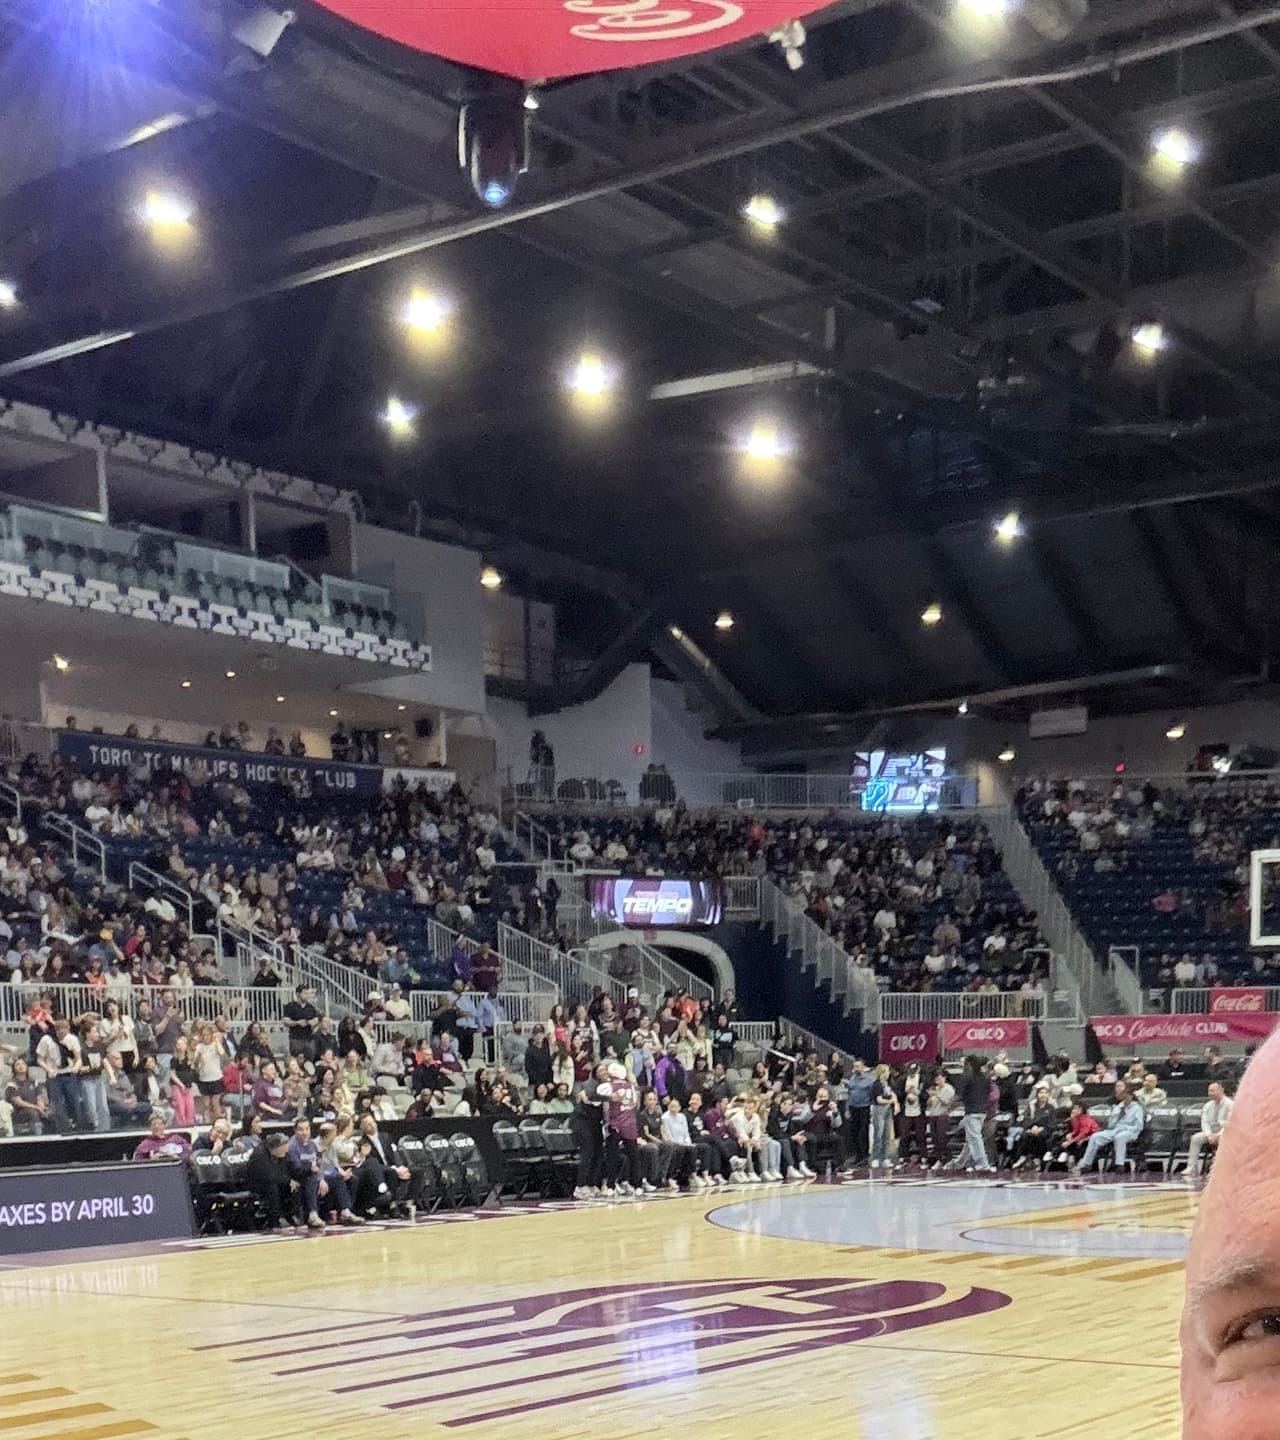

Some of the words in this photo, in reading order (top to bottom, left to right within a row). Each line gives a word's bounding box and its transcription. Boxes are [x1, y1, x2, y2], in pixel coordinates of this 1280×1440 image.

[89, 745, 162, 771] TOROTO
[245, 763, 307, 783] HOCEY
[314, 769, 356, 789] LUB
[622, 897, 693, 913] TEMPO
[1214, 994, 1263, 1011] Coca-Cola
[966, 1028, 995, 1041] CIBC
[1128, 1019, 1193, 1040] Courtside
[1195, 1022, 1229, 1034] CLUB
[890, 1034, 916, 1051] CIBC
[51, 1200, 76, 1223] BY
[77, 1196, 130, 1221] APRIL
[132, 1194, 154, 1215] 30
